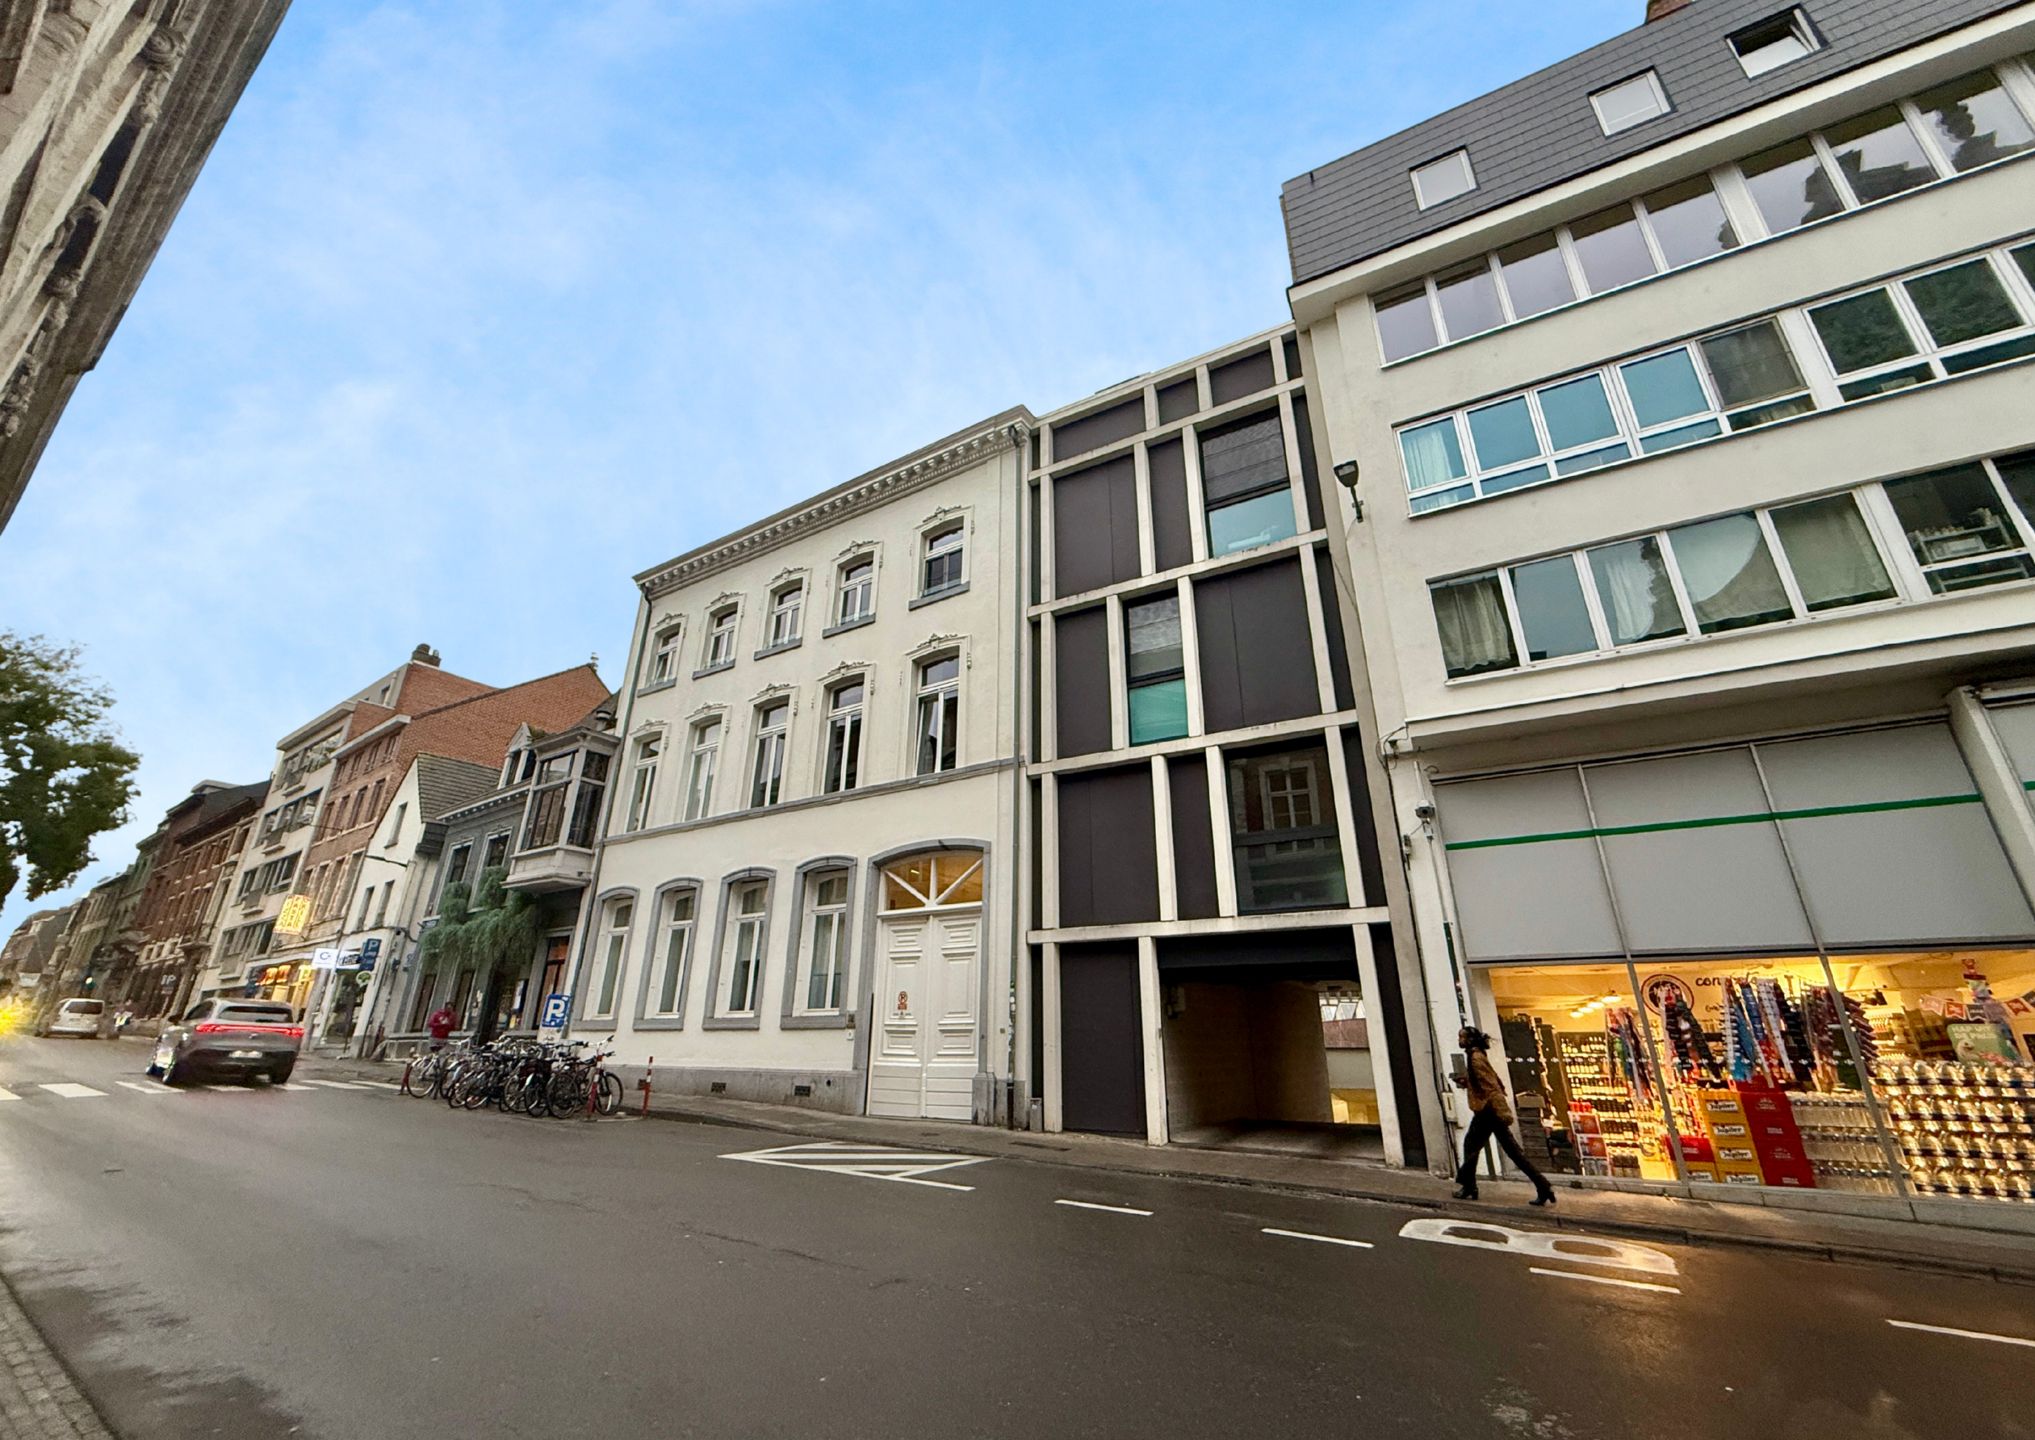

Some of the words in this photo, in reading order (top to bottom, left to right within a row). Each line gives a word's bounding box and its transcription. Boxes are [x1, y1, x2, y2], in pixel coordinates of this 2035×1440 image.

[545, 998, 566, 1022] P
[1709, 1102, 1736, 1110] Jupiler
[1722, 1150, 1748, 1158] Jupiler
